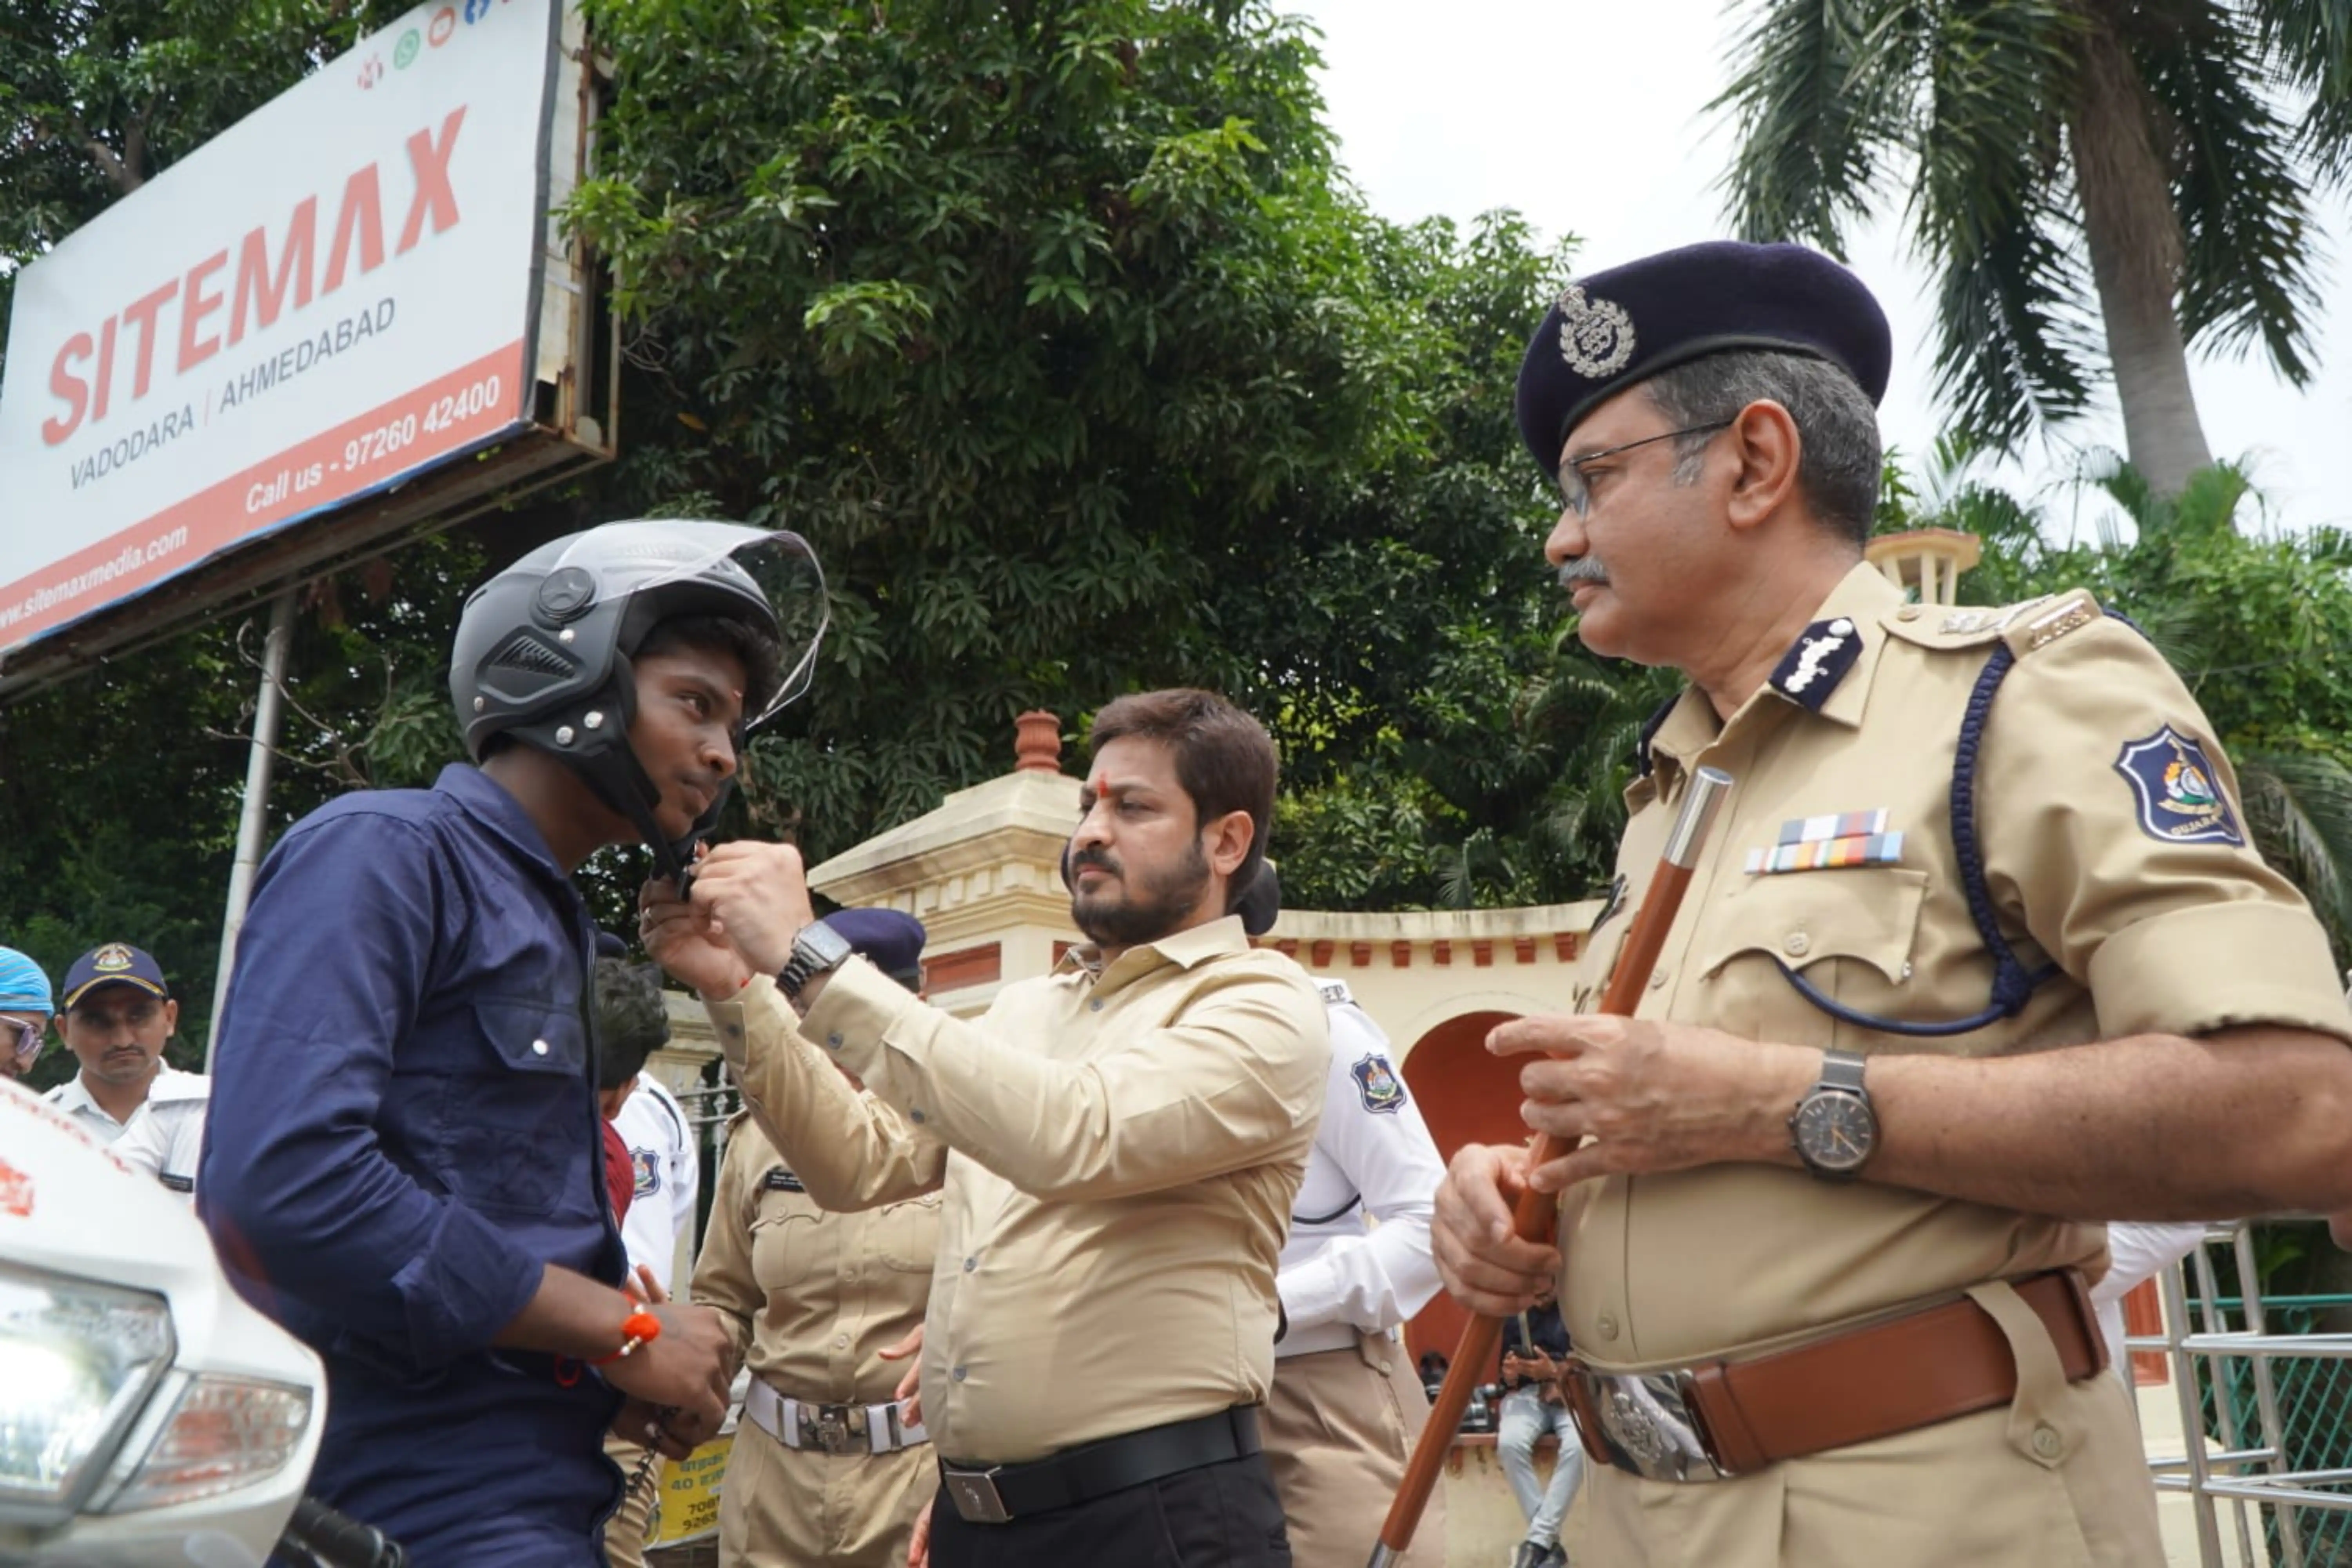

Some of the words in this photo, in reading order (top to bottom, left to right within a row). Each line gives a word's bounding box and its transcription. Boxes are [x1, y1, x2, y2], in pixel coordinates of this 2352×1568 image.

[42, 103, 468, 446] SITEMAX
[71, 404, 194, 490] VADODARA
[220, 297, 396, 414] AHMEDABAD
[246, 470, 289, 514] Call
[295, 463, 322, 492] us
[344, 414, 416, 471] 97260
[423, 375, 500, 433] 42400
